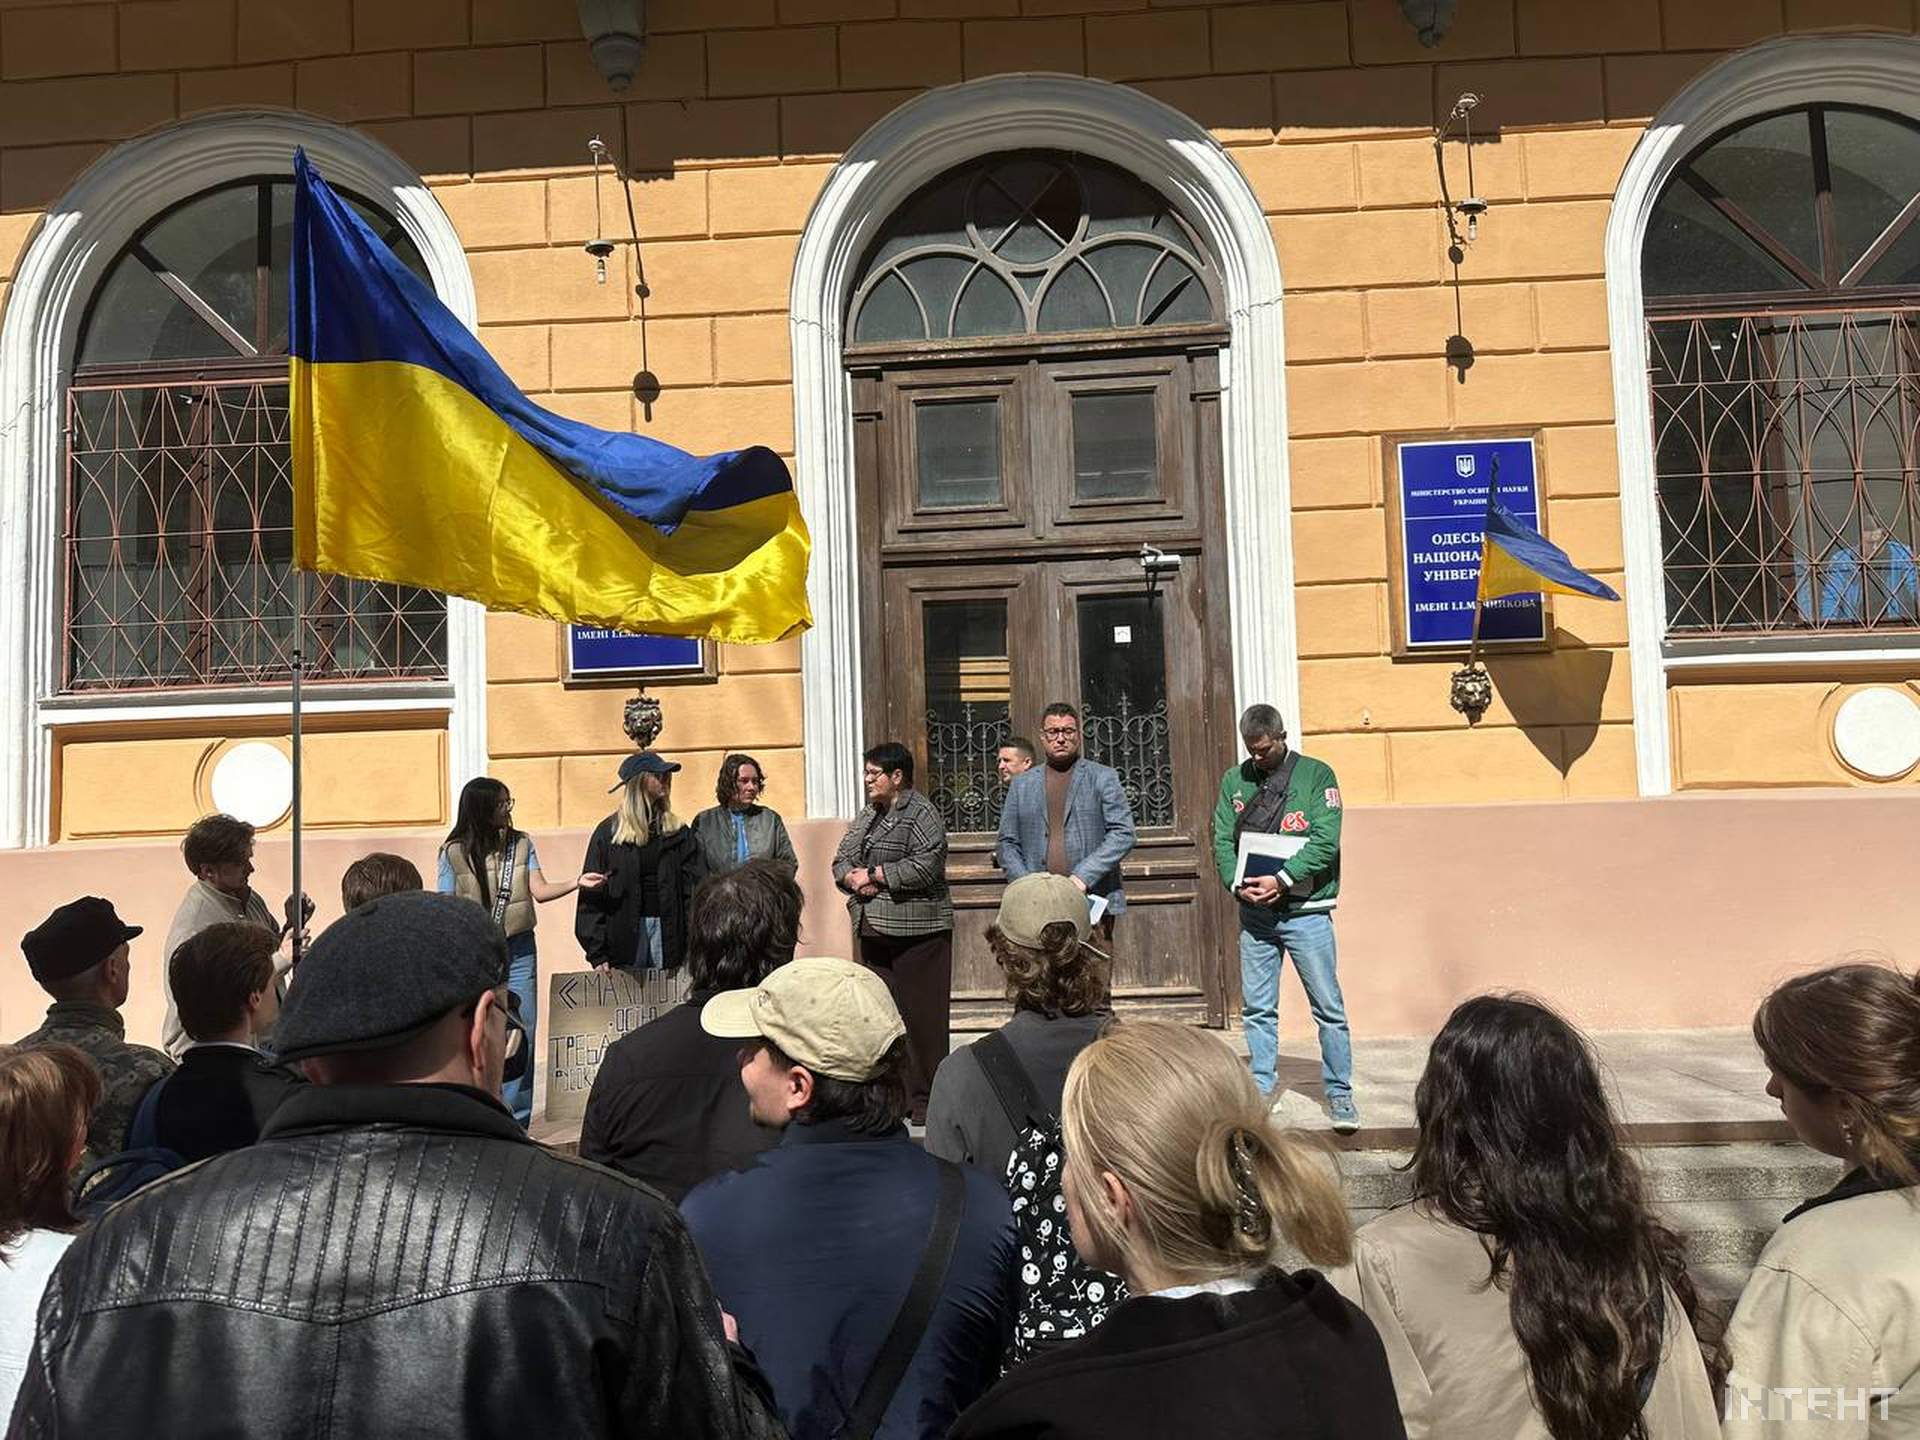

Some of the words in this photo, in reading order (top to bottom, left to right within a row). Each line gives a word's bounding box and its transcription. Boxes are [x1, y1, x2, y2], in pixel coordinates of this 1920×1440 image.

[1467, 486, 1490, 495] ОСВІТ
[1415, 602, 1449, 612] ІМЕНІ
[1451, 599, 1537, 611] І.І.МЧНИКОВА
[577, 630, 609, 640] ІМЕНІ
